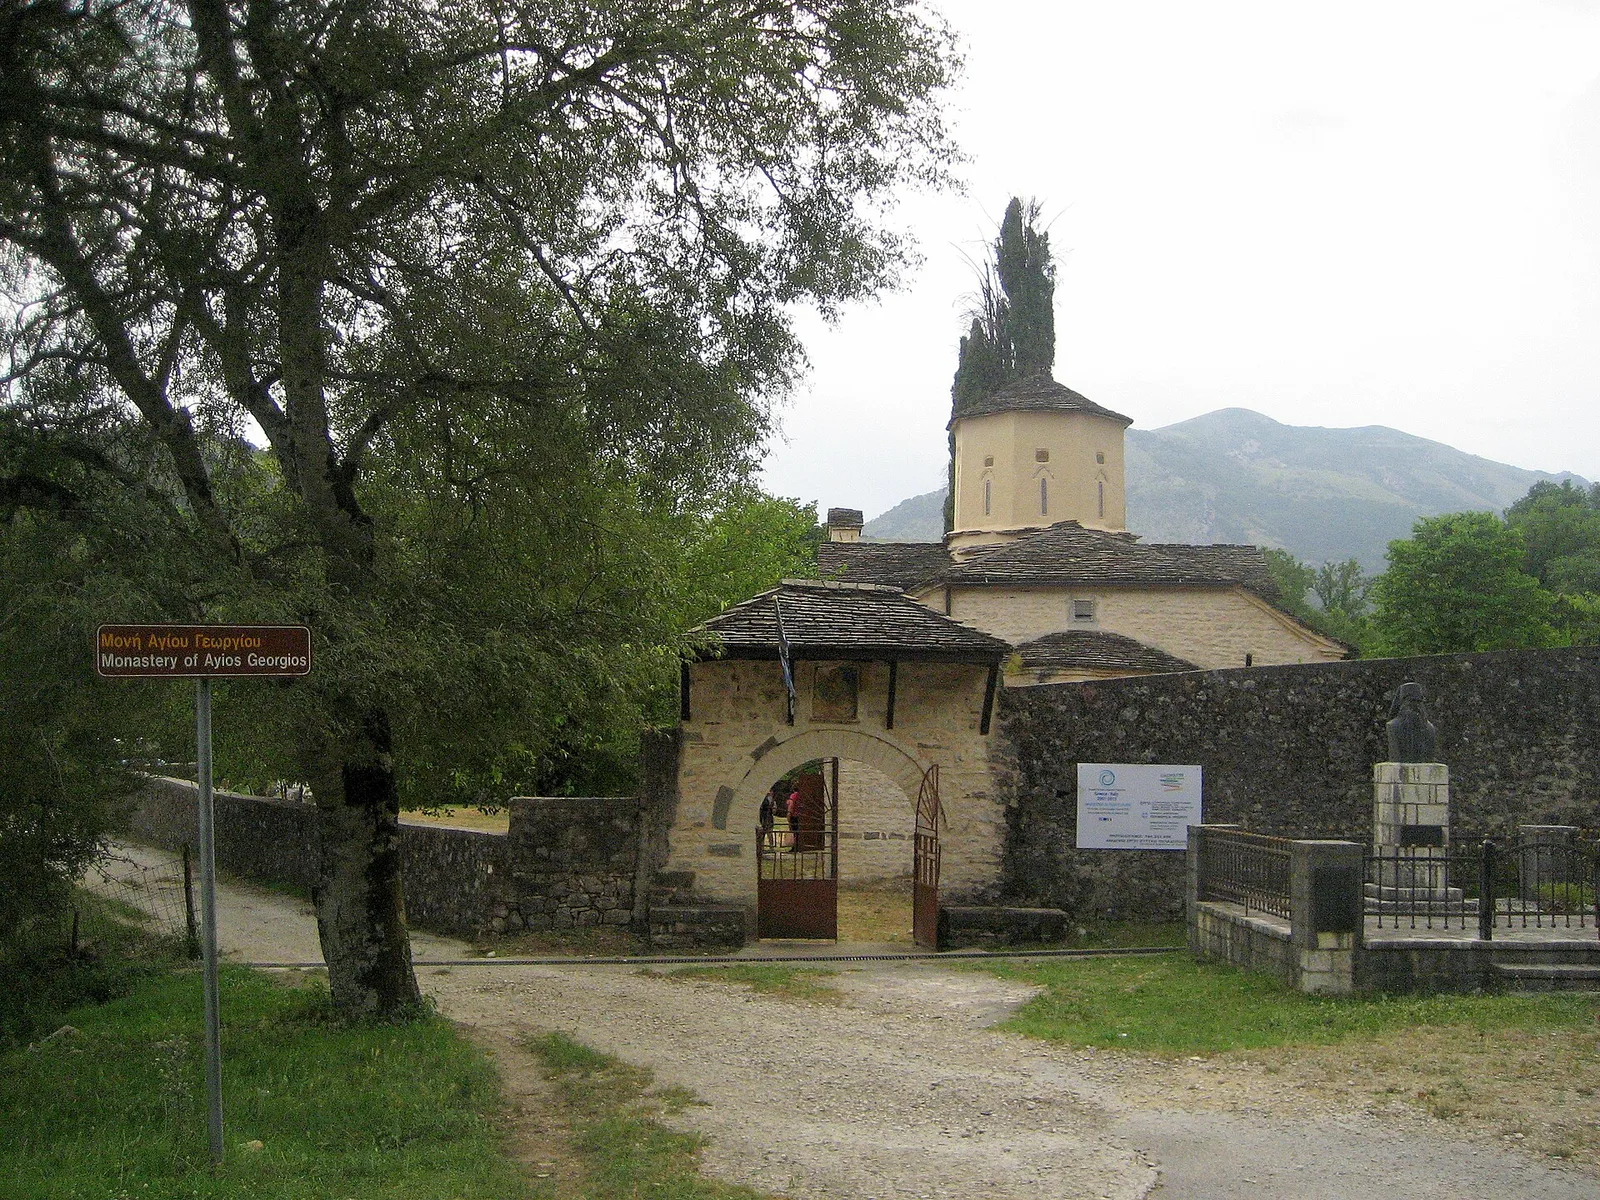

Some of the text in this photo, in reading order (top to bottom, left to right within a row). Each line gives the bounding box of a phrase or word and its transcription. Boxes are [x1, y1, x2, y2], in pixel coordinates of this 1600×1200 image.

[101, 634, 261, 651] Μονή Αγίου Γεωργίου
[102, 653, 307, 669] Monastery of Ayios Georgios
